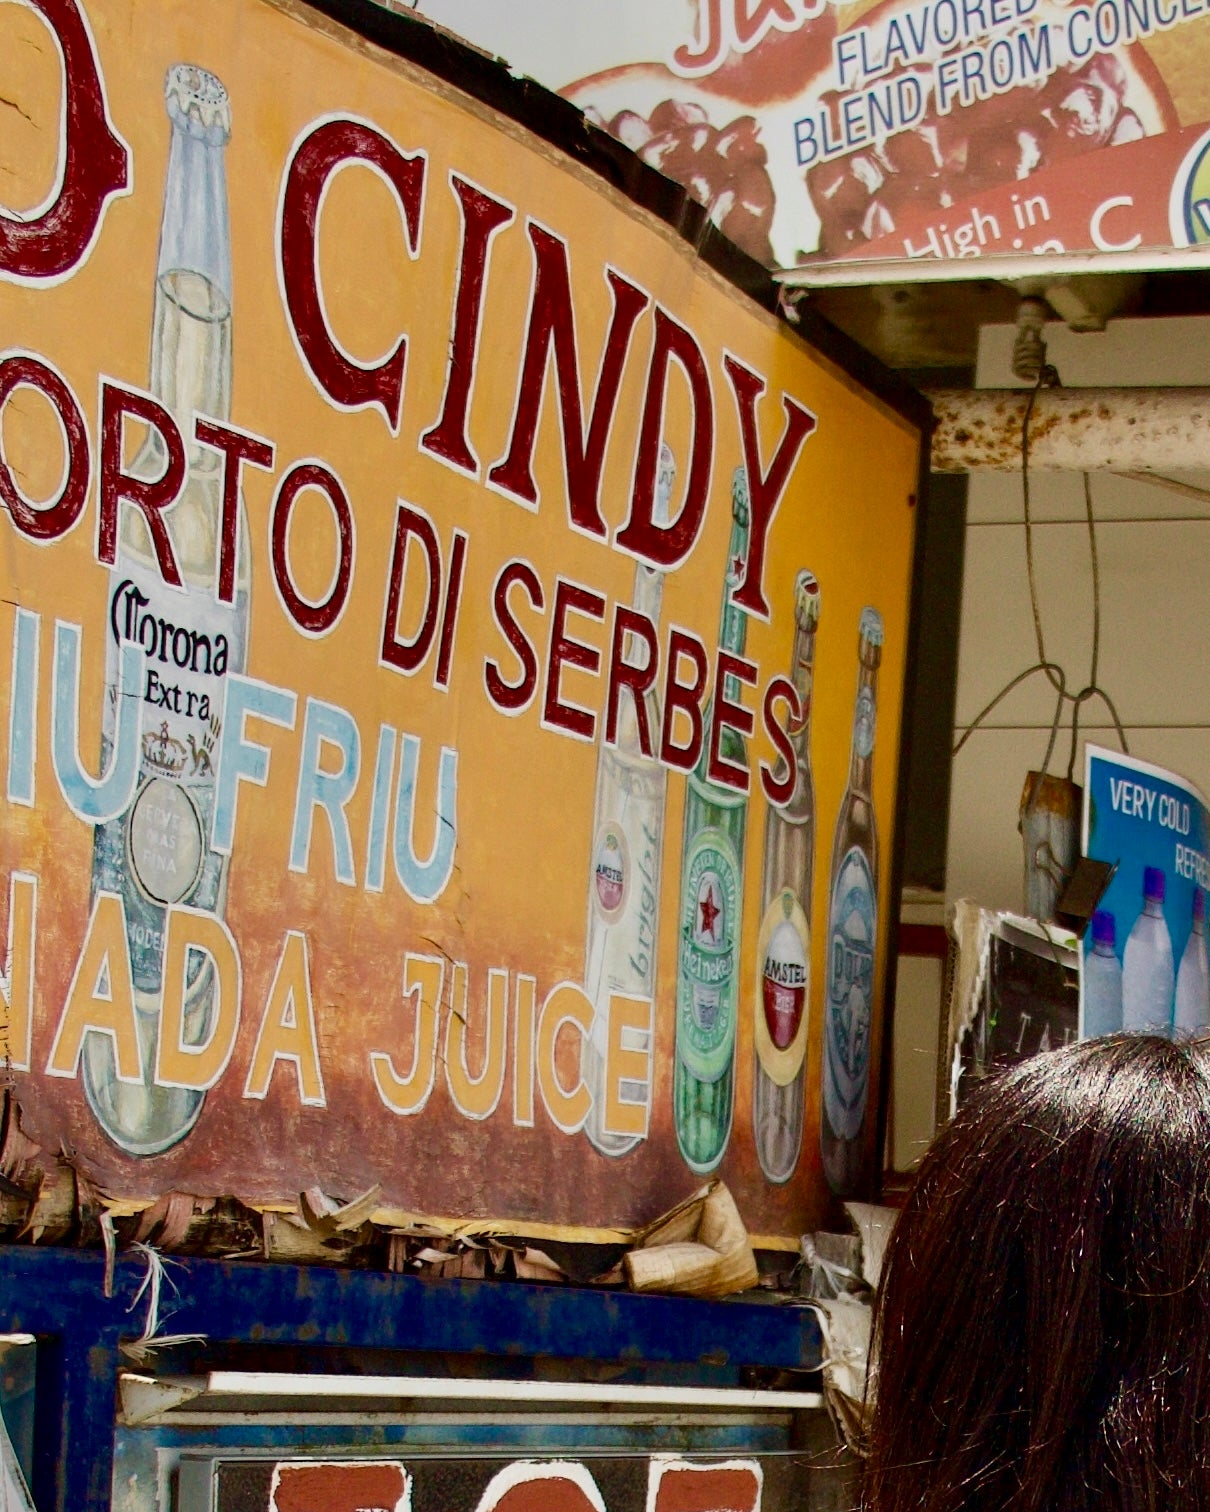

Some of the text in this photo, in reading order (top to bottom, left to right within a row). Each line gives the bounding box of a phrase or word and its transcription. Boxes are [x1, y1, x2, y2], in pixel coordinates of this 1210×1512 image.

[794, 76, 922, 167] BLEND
[938, 24, 1052, 110] FROM
[1011, 193, 1052, 232] in
[276, 111, 818, 622] CINDY
[144, 669, 212, 721] Extra
[379, 497, 471, 692] DI
[484, 559, 805, 809] SERBES
[210, 671, 459, 905] FRIU
[1109, 777, 1191, 836] VERY COLD
[763, 955, 807, 984] AMSTEL
[370, 951, 654, 1139] JUICE
